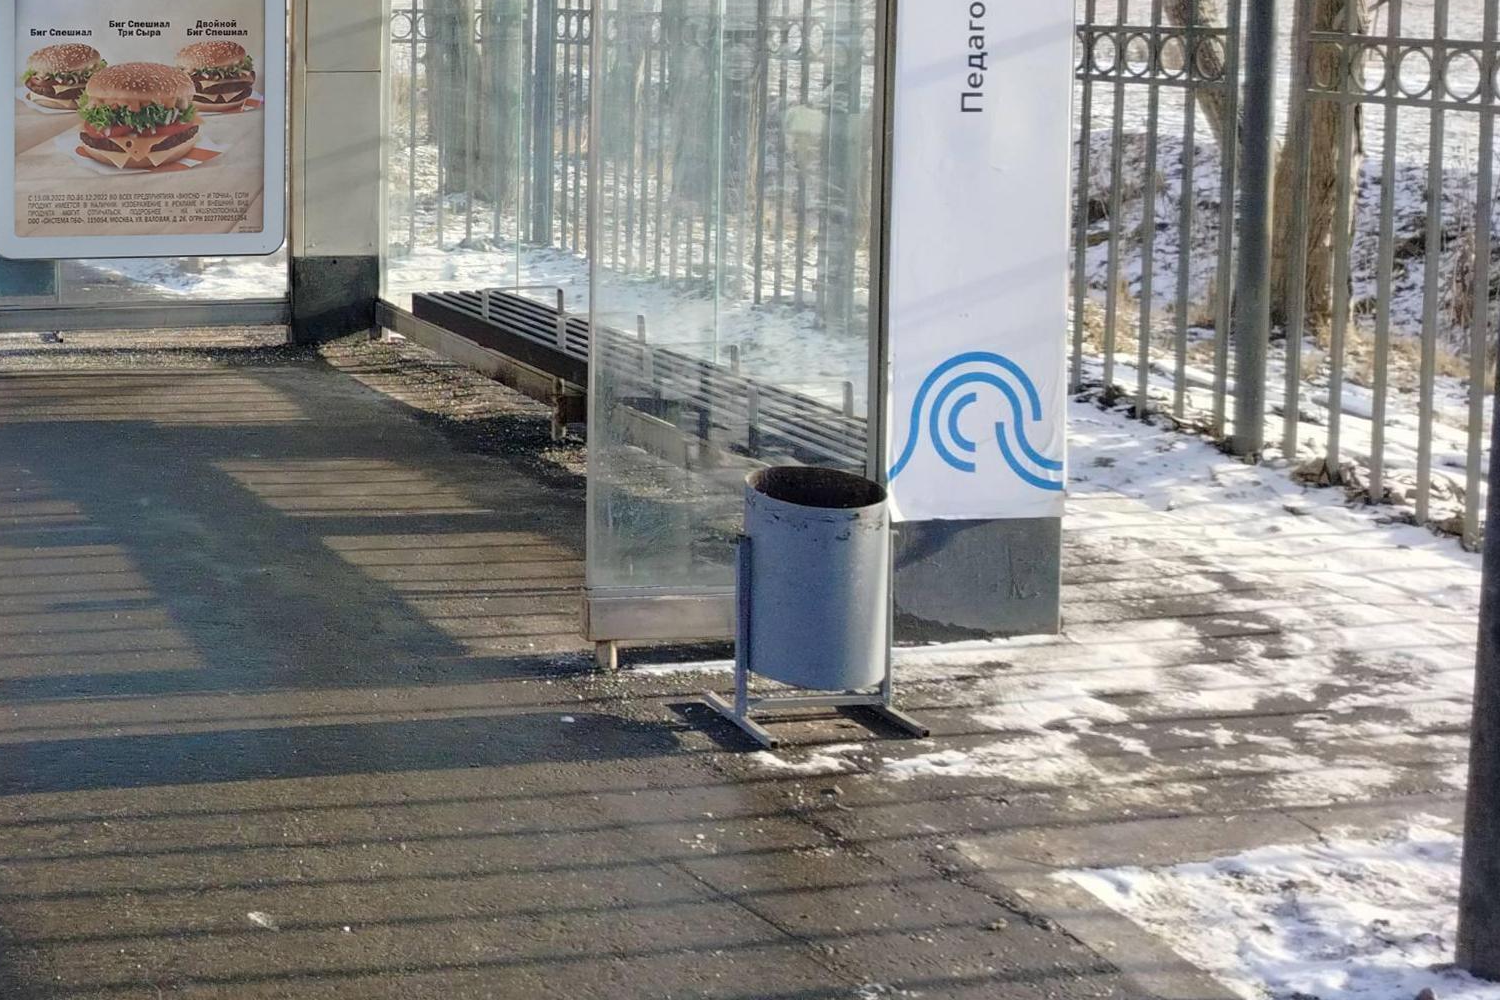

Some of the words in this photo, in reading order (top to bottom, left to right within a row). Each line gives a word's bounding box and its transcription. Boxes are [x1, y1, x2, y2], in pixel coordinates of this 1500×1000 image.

[109, 20, 126, 28] Биг
[127, 20, 171, 28] Спешиал
[195, 19, 237, 29] Двойной
[30, 28, 48, 37] Биг
[49, 28, 93, 37] Спешиал
[117, 28, 134, 38] Три
[135, 28, 161, 38] Сыра
[186, 28, 204, 37] Биг
[205, 28, 249, 37] Спешиал
